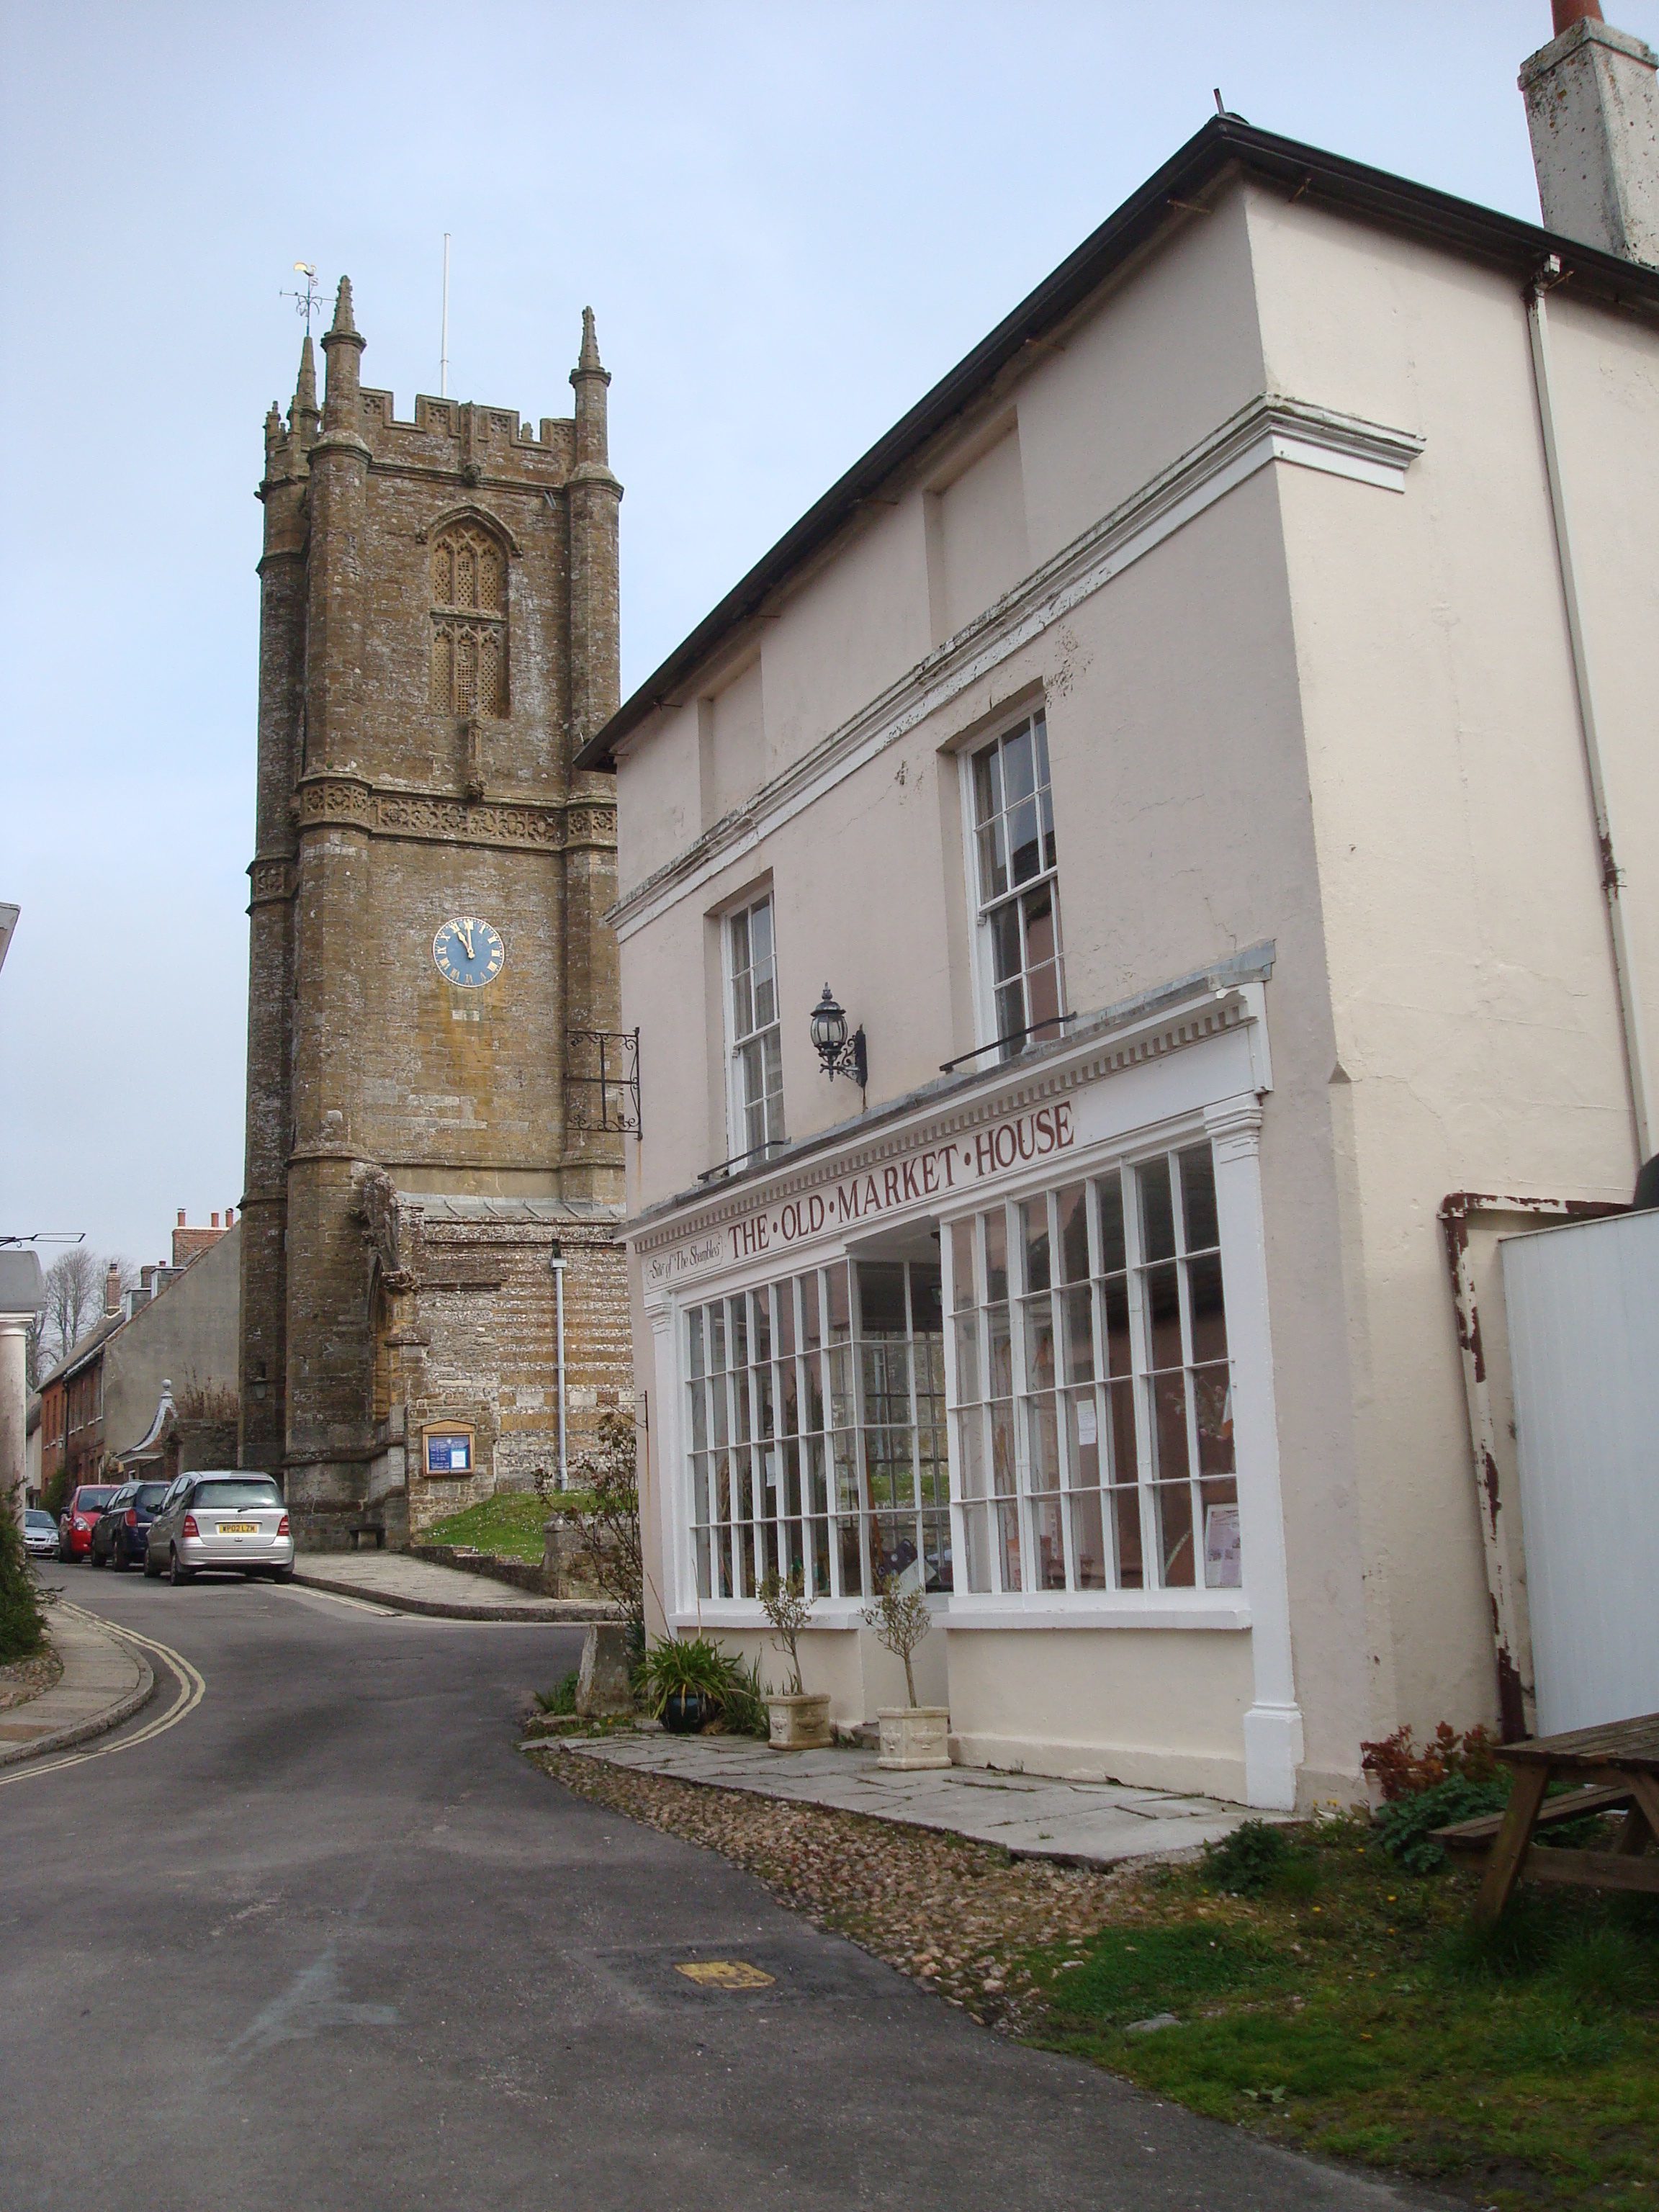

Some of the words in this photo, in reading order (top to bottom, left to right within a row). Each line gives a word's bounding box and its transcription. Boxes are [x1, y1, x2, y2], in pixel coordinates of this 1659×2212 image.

[728, 1214, 770, 1259] THE
[781, 1195, 824, 1241] OLD
[837, 1143, 959, 1223] MARKET
[974, 1100, 1075, 1177] HOUSE
